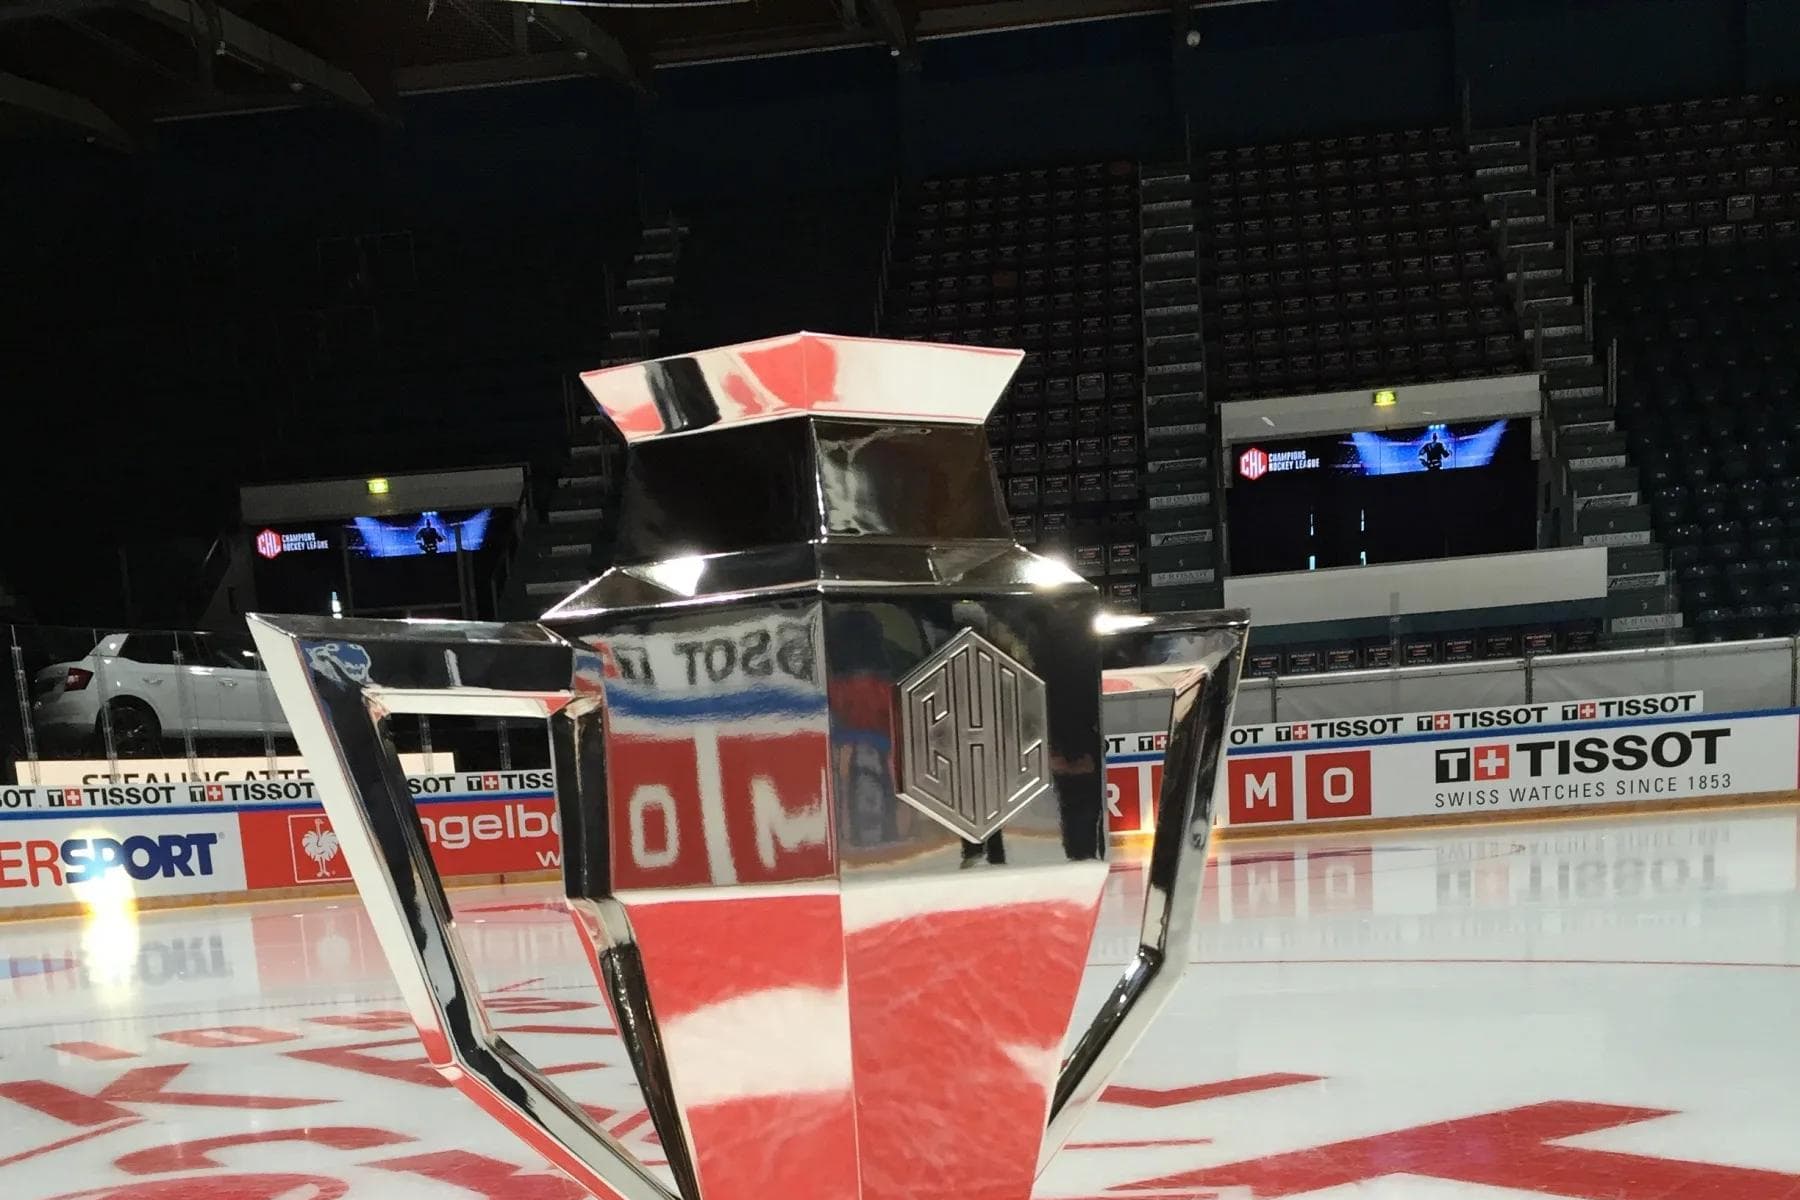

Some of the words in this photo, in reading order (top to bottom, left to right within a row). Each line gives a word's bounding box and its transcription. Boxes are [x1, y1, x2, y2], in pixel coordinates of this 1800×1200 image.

[1240, 447, 1268, 480] CHL
[1268, 450, 1306, 462] CHAMPIONS
[1268, 460, 1294, 472] HOCKEY
[1295, 458, 1320, 469] LEAGUE
[257, 529, 281, 559] CHL
[1311, 717, 1403, 739] TISSOT
[1453, 706, 1548, 728] TISSOT
[1599, 695, 1696, 718] TISSOT
[905, 643, 1044, 830] CHL
[1516, 728, 1731, 777] TISSOT
[83, 786, 175, 806] TISSOT
[225, 782, 315, 801] TISSOT
[1435, 788, 1499, 808] SWISS
[1509, 782, 1605, 803] WATCHES
[1616, 777, 1677, 795] SINCE
[1688, 773, 1731, 790] 1853
